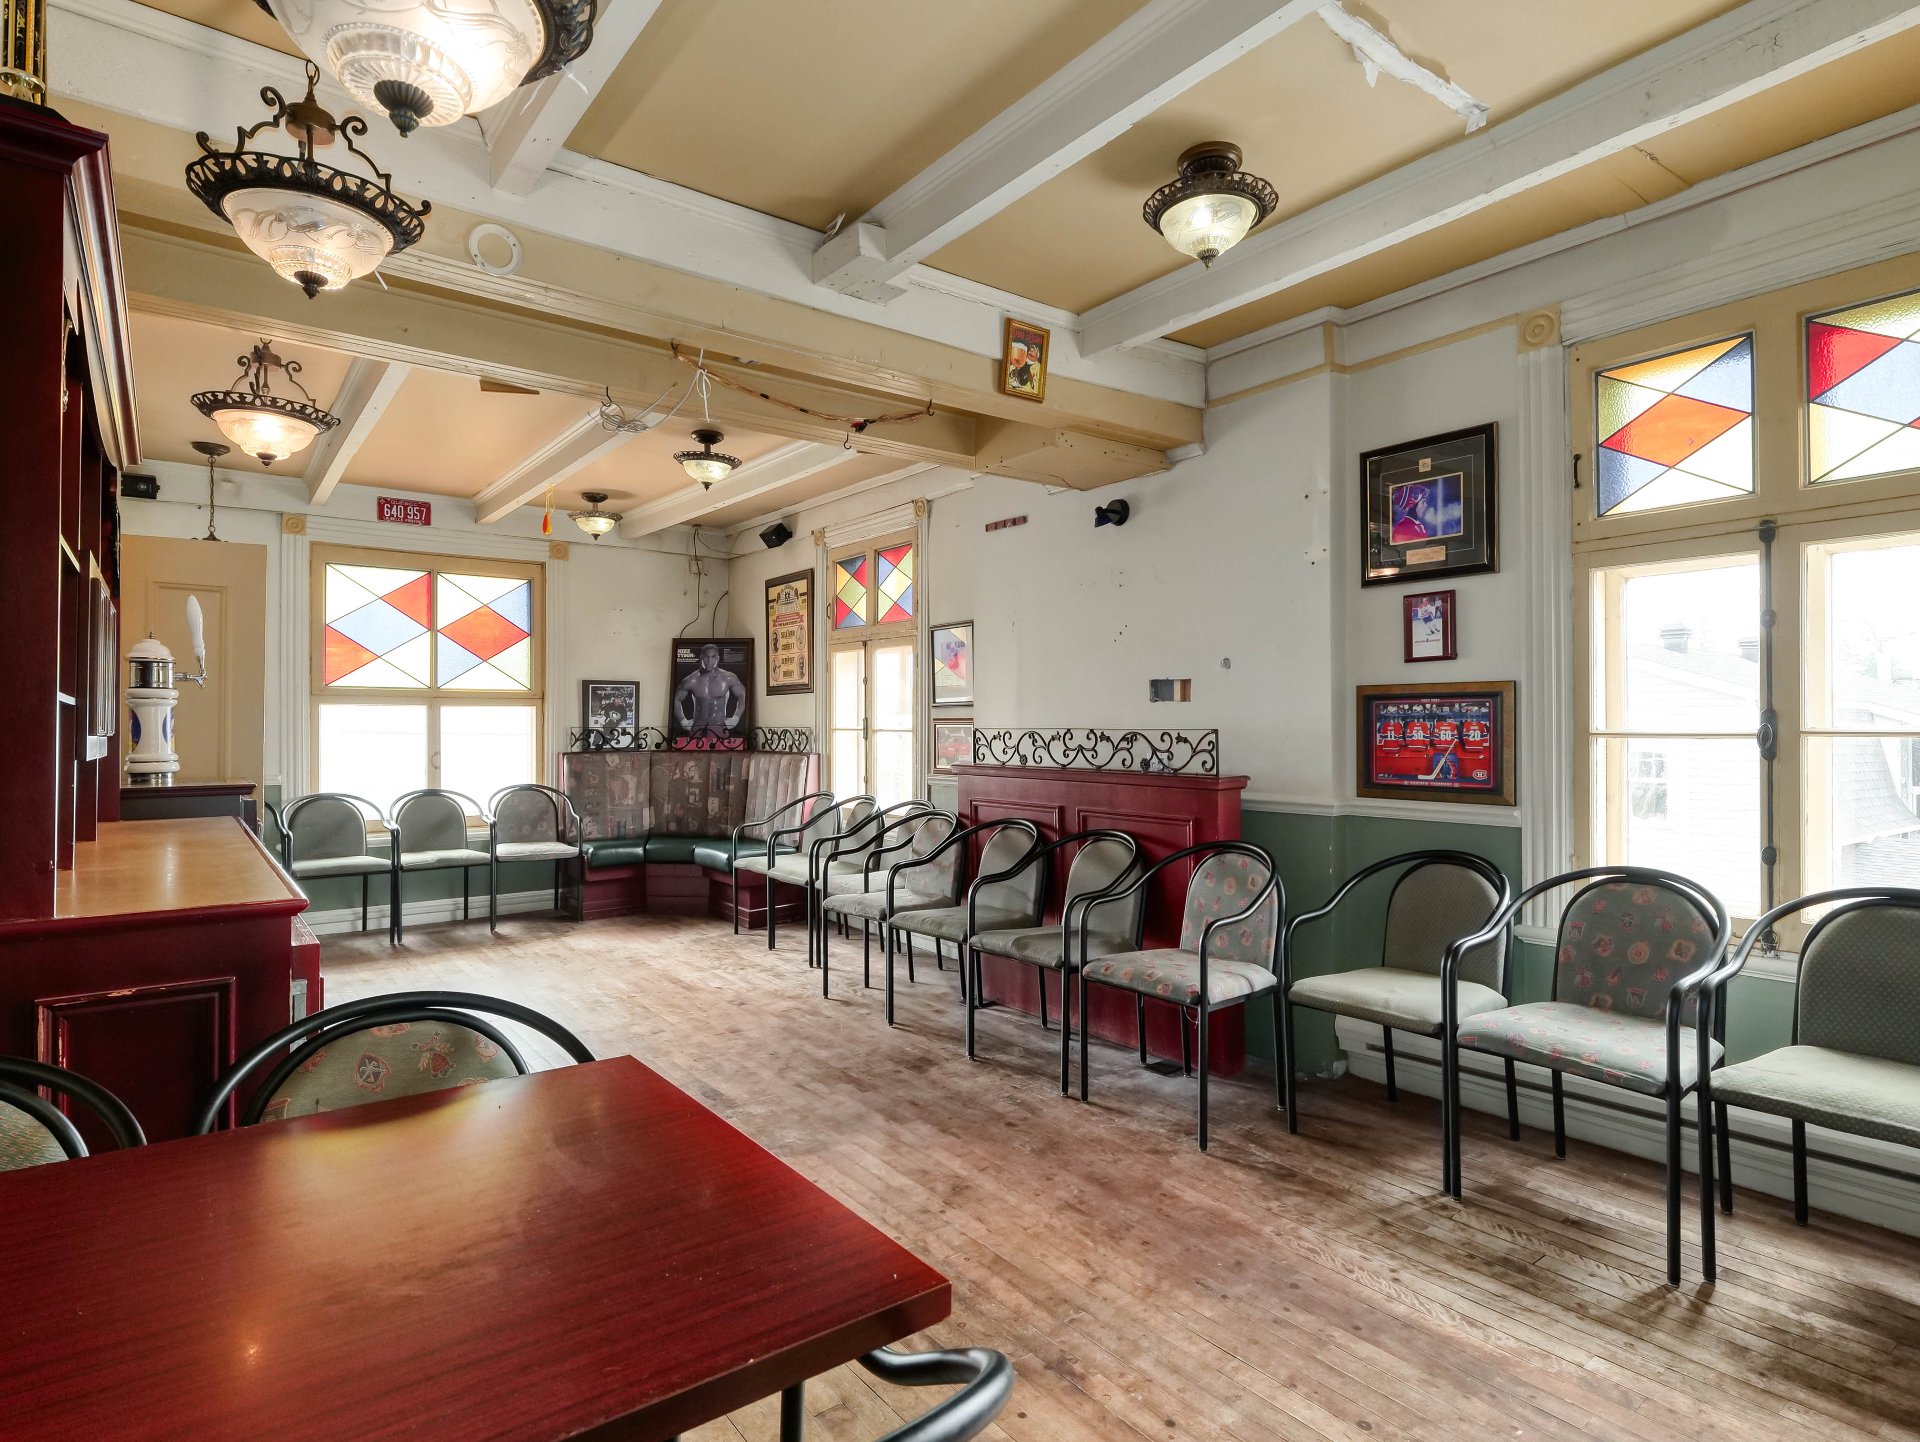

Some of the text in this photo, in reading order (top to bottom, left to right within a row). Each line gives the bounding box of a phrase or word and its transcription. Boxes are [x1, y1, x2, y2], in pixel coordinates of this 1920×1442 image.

[384, 504, 426, 521] 640 957
[1387, 730, 1395, 740] 11
[1412, 730, 1423, 740] 50
[1440, 730, 1451, 740] 60
[1469, 730, 1481, 740] 20
